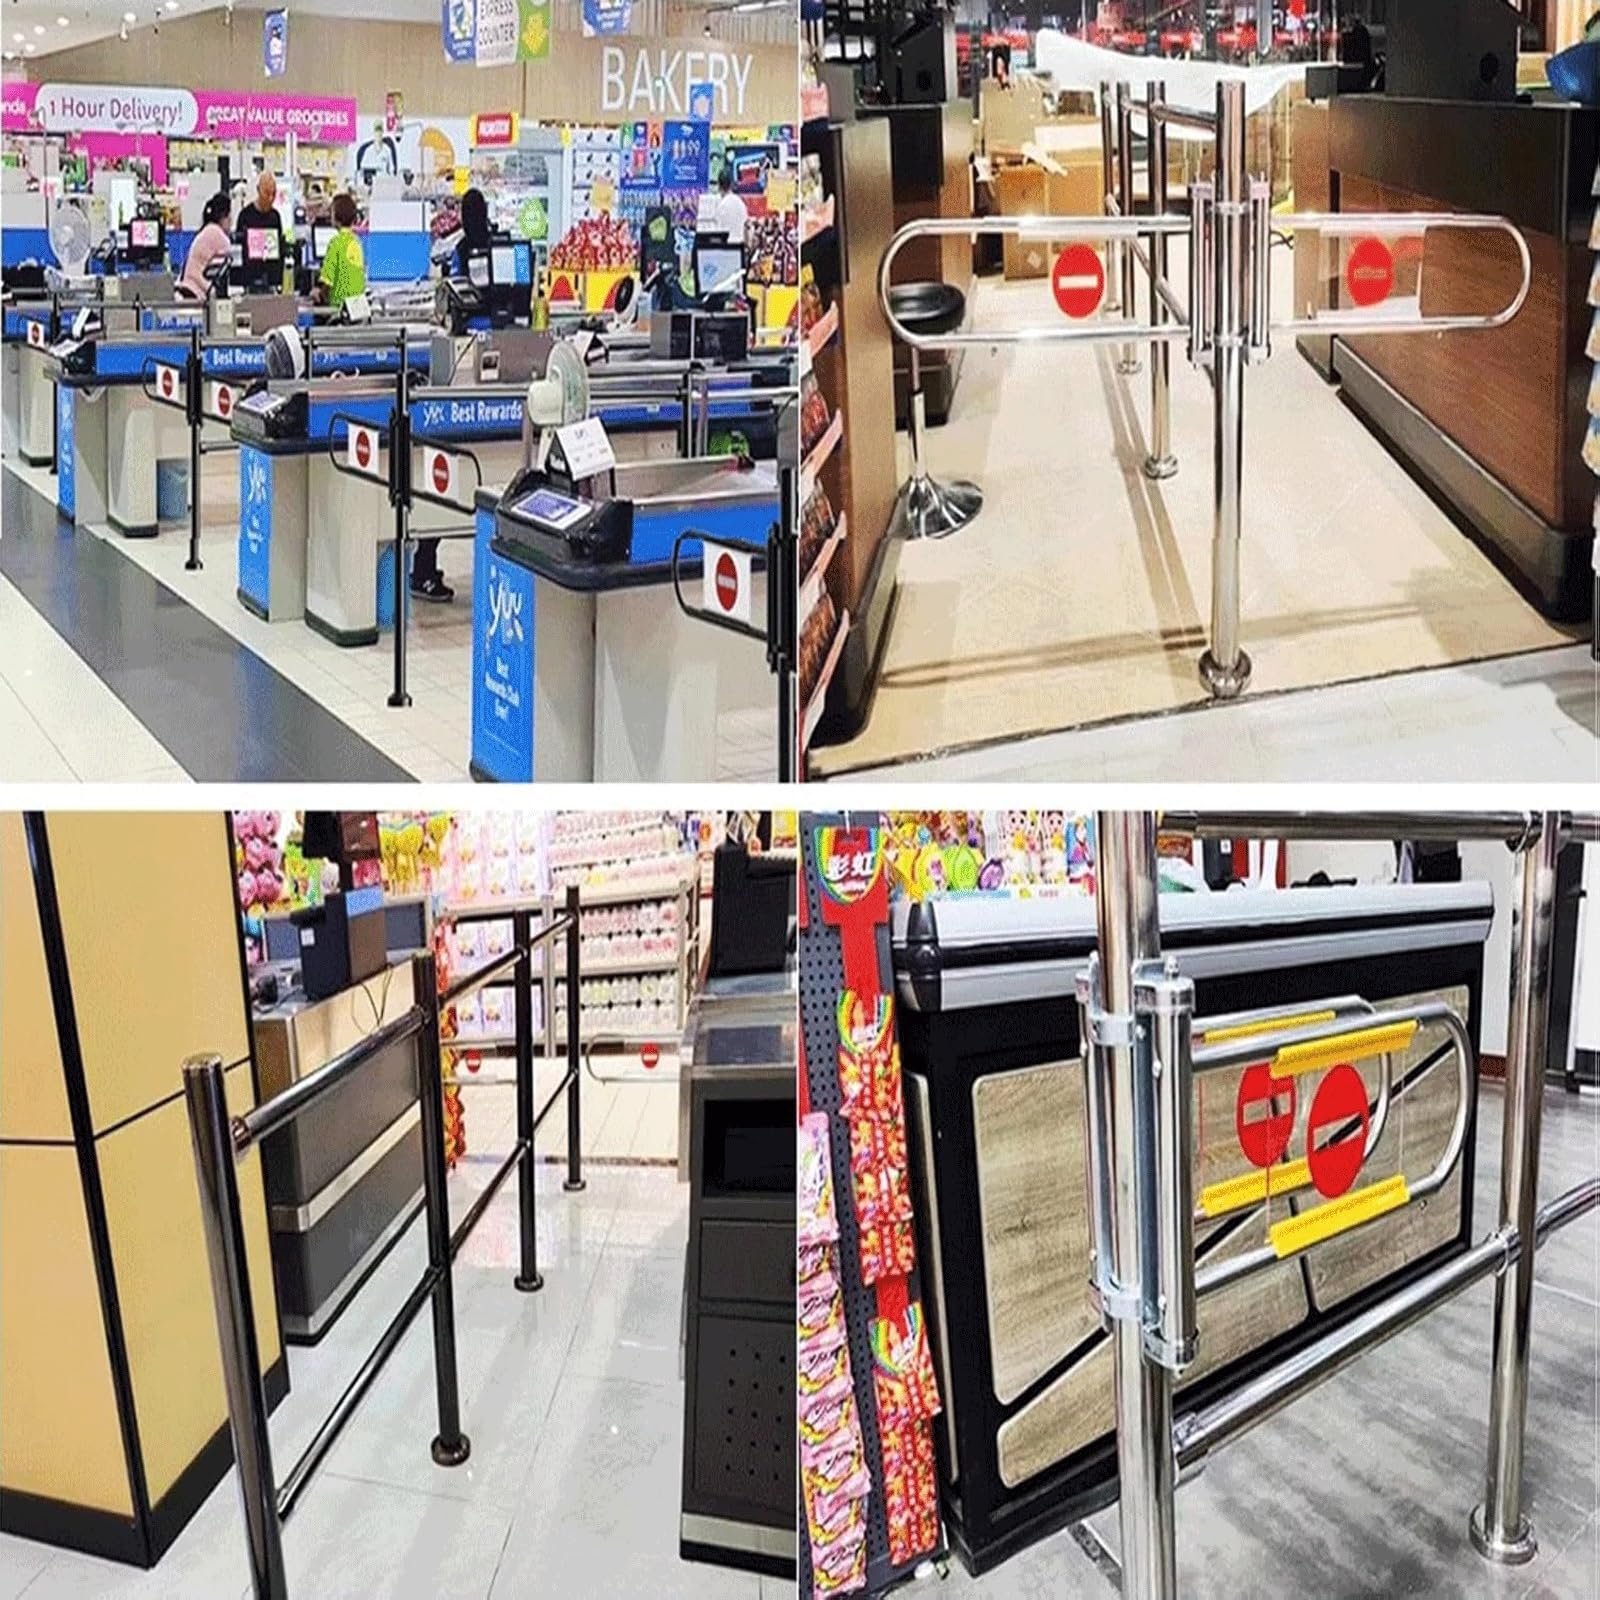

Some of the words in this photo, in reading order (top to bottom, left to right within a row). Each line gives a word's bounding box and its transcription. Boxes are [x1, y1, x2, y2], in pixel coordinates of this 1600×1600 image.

[602, 47, 754, 115] BAKERY
[50, 101, 56, 115] 1
[61, 97, 105, 119] Hour
[110, 99, 184, 127] Delivery!
[205, 105, 245, 122] GREAT
[247, 107, 285, 124] VALUE
[286, 109, 349, 126] GROCERIES
[235, 348, 266, 366] Rewar
[451, 402, 475, 423] Best
[477, 400, 523, 421] Rewards
